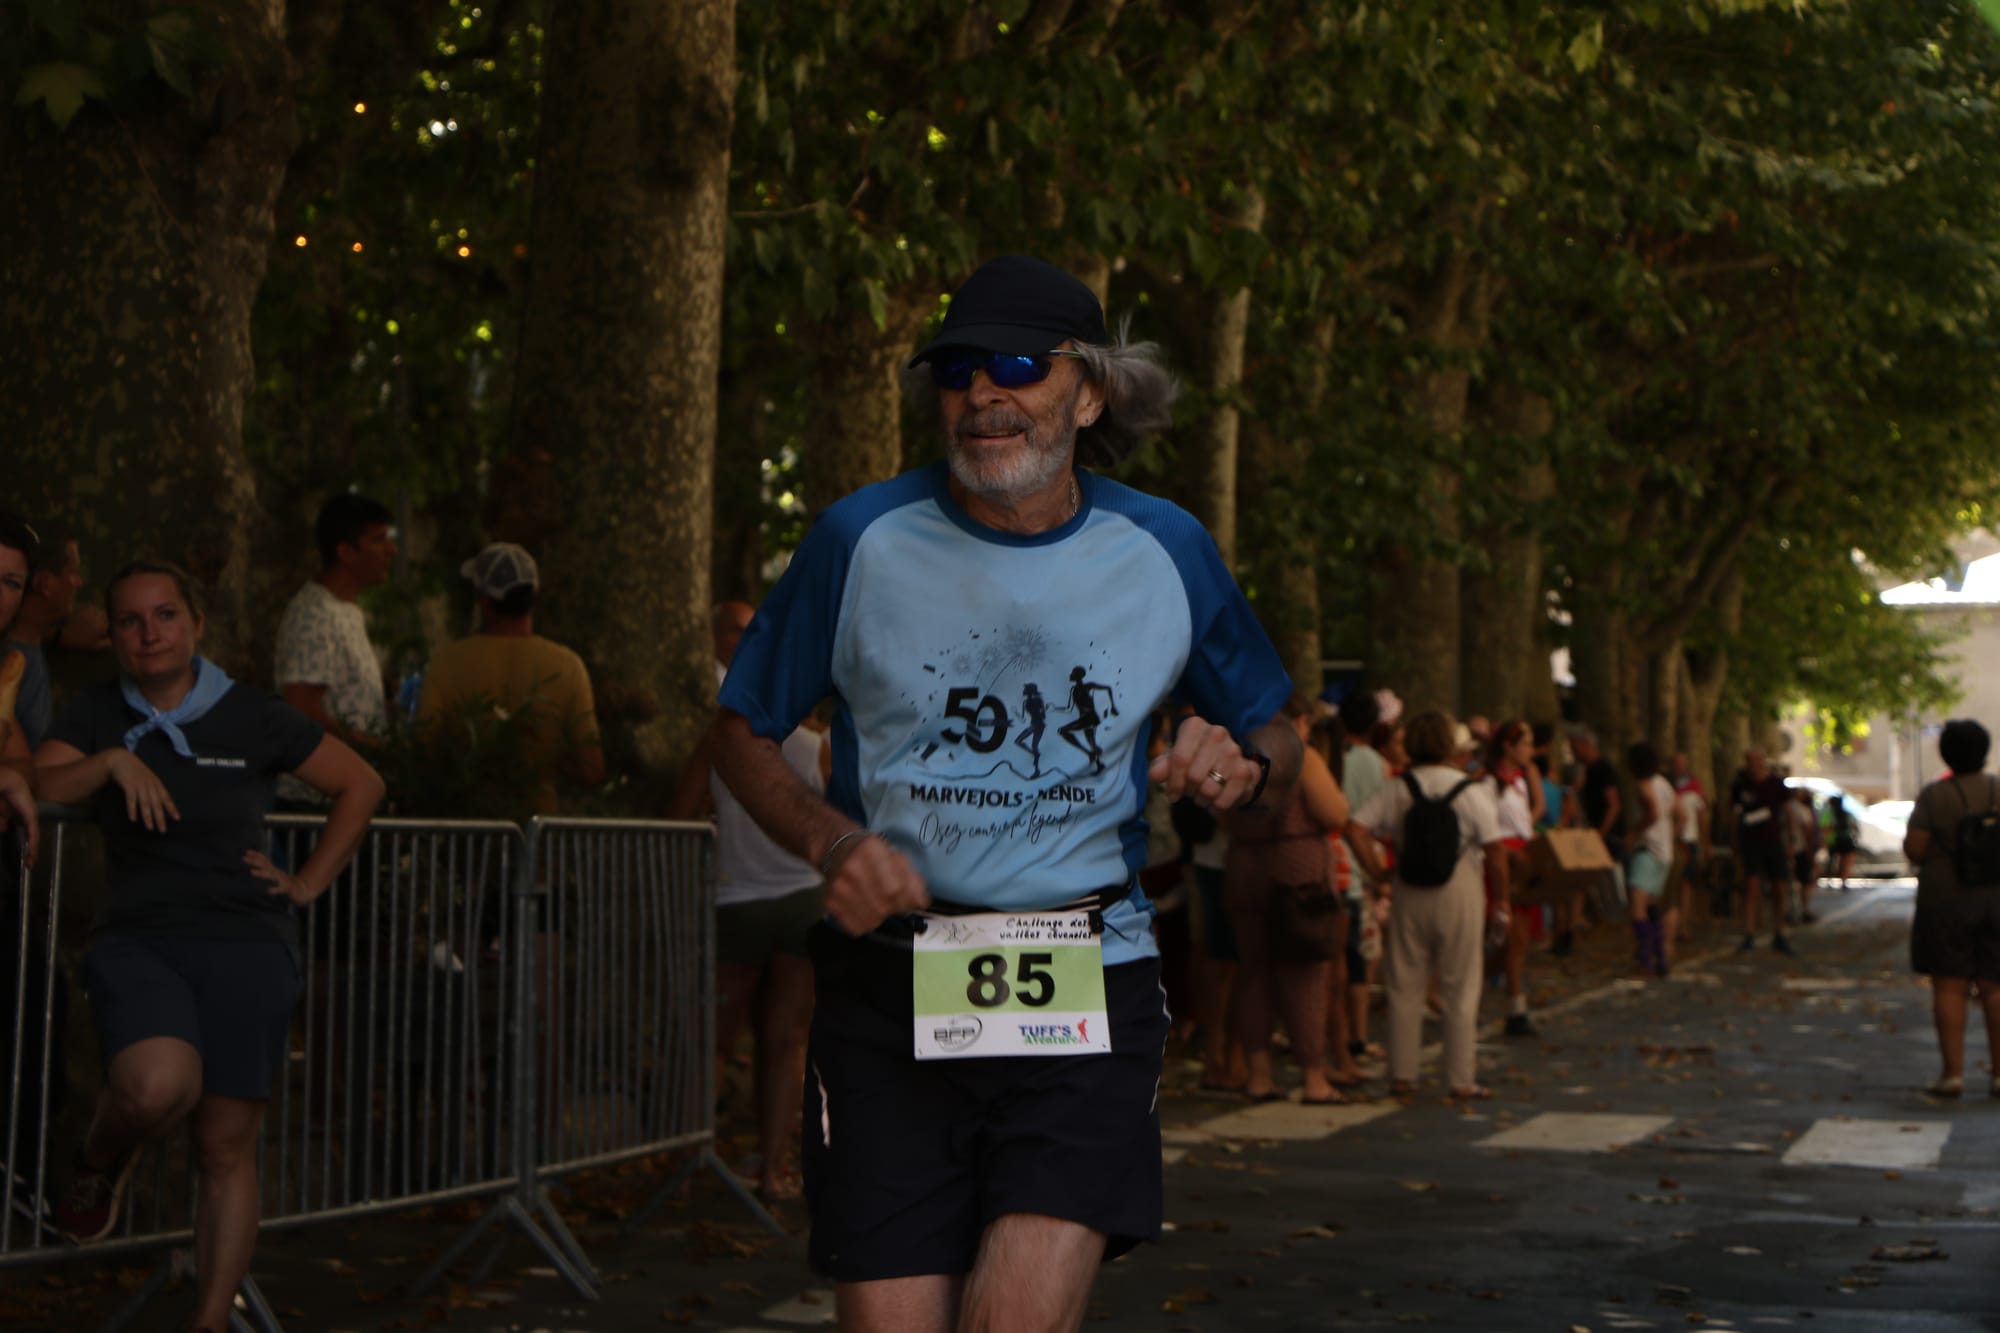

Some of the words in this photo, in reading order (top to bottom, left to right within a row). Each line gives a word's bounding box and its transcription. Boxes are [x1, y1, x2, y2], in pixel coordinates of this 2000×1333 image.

[941, 687, 1008, 753] 50
[1006, 917, 1064, 931] Challenge
[966, 952, 1056, 1009] 85
[1018, 1023, 1073, 1037] TUFF'S
